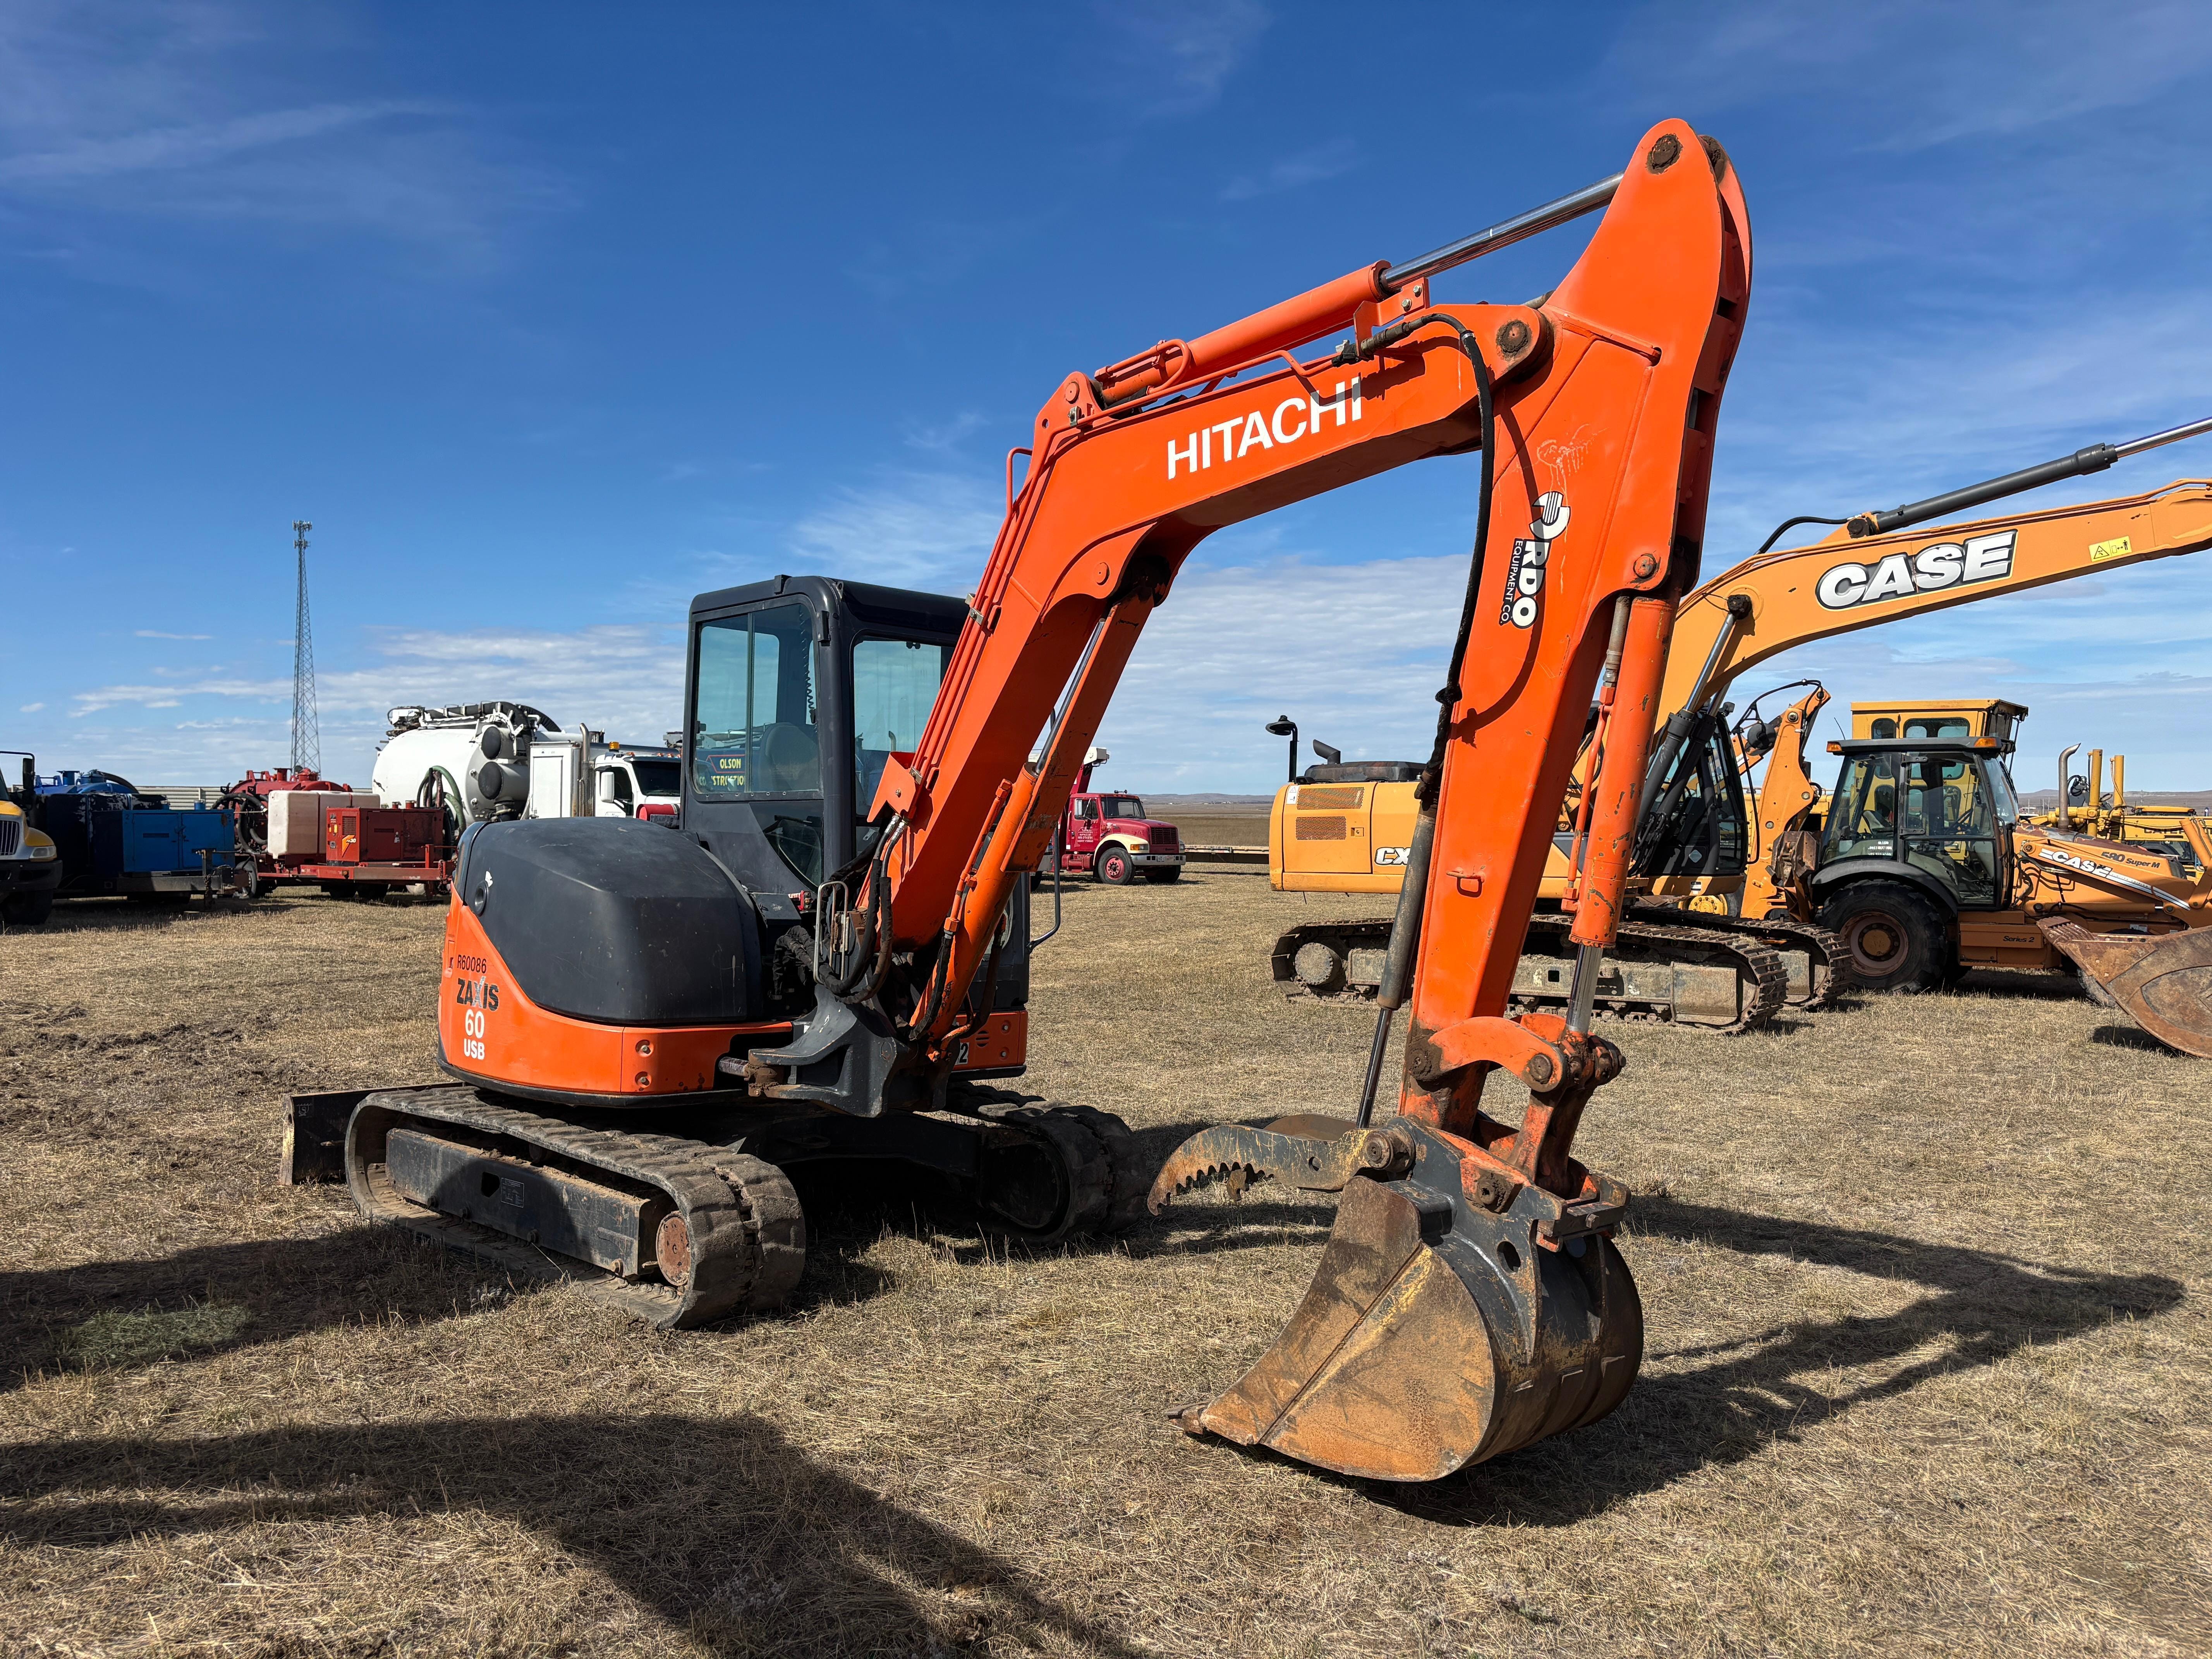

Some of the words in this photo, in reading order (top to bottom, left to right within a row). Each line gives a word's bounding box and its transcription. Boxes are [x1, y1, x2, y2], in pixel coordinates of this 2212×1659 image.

[1168, 376, 1361, 480] HITACHI
[1505, 540, 1523, 601] EQUIPMENT
[1818, 530, 2016, 608] CASE
[1499, 605, 1511, 624] CO.
[720, 758, 741, 769] OLSON
[2052, 851, 2113, 878] CASE
[2101, 852, 2126, 862] 580
[2126, 858, 2150, 867] Super
[457, 954, 487, 974] R60086
[457, 975, 499, 1011] ZAXIS
[465, 1009, 484, 1039] 60
[464, 1038, 485, 1060] USB
[957, 1043, 969, 1063] 2
